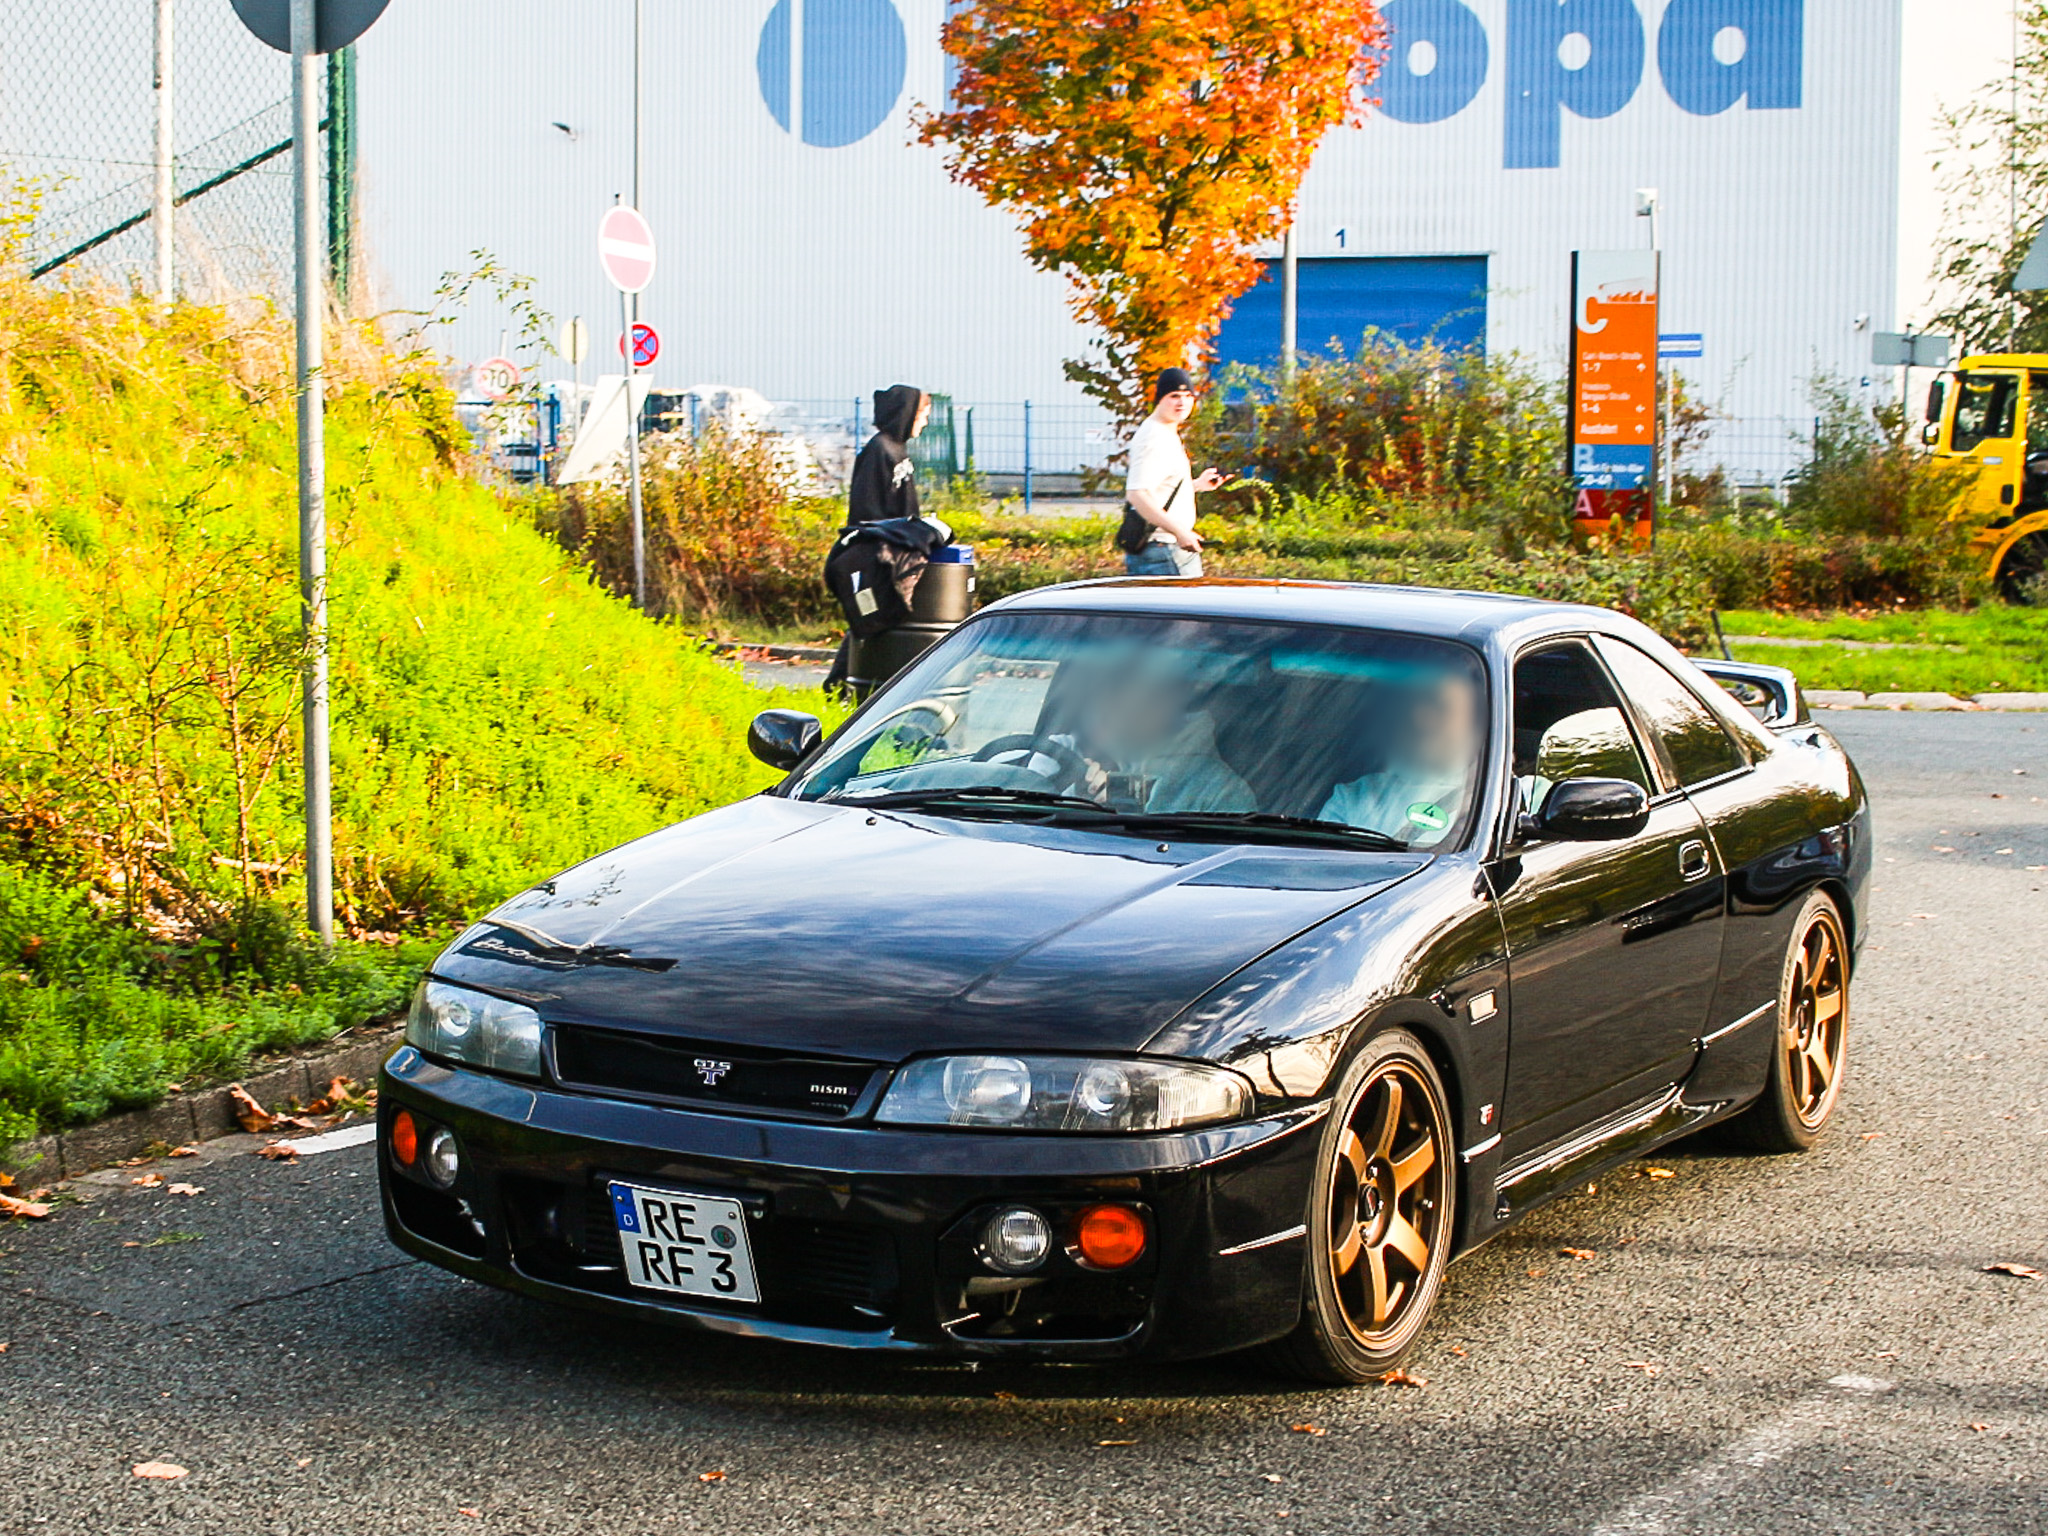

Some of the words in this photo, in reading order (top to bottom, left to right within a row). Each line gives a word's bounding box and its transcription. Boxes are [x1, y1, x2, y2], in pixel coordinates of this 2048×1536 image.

[1335, 228, 1345, 248] 1
[488, 368, 509, 388] 70
[1575, 443, 1594, 472] B
[1576, 488, 1594, 517] A
[1422, 804, 1435, 818] 4
[623, 1213, 634, 1227] D
[641, 1197, 706, 1245] RE
[638, 1240, 694, 1286] RF
[707, 1251, 738, 1292] 3
